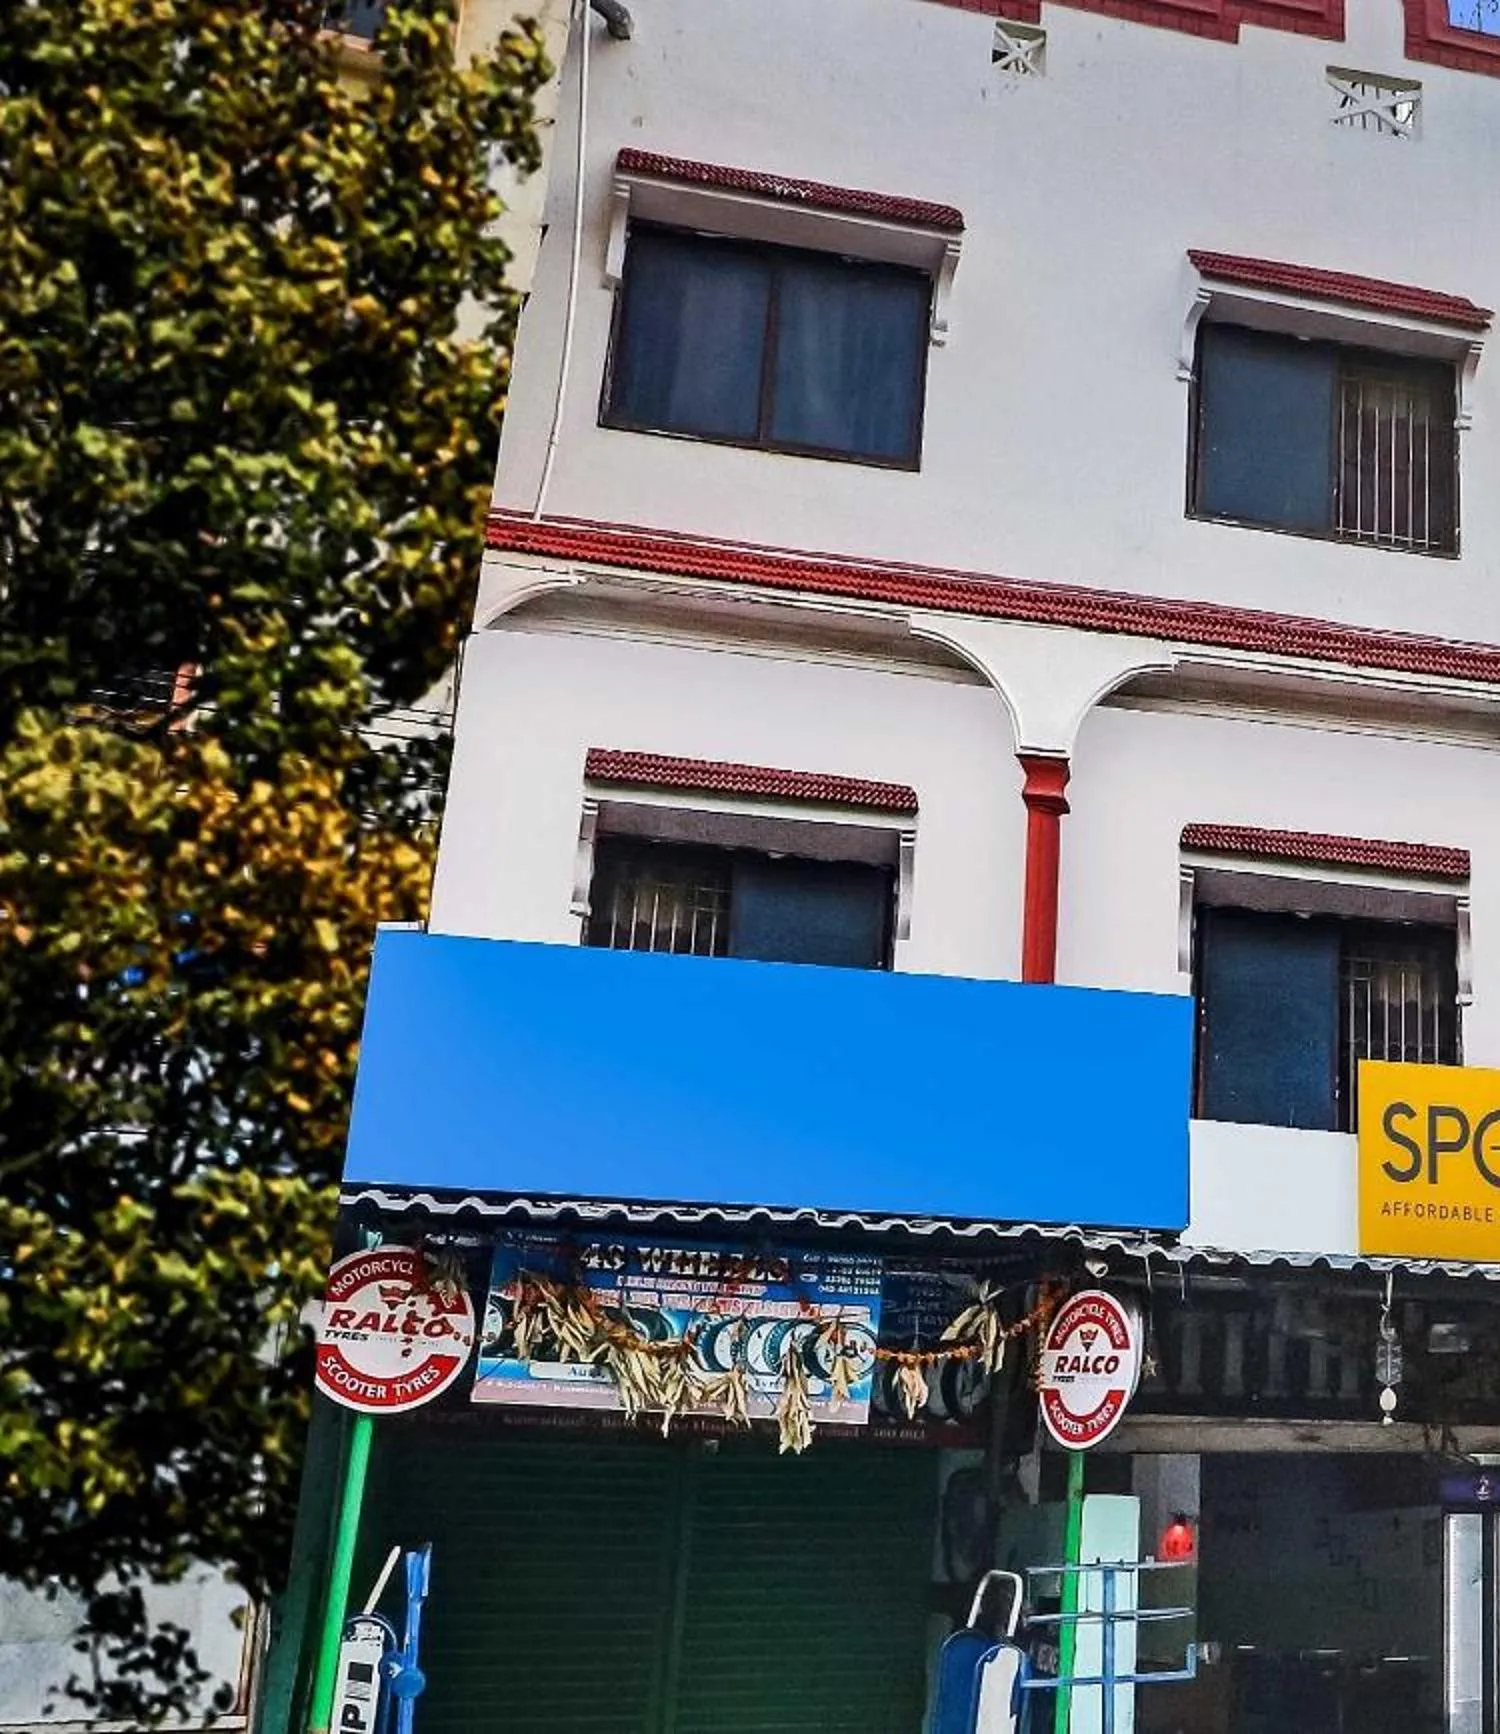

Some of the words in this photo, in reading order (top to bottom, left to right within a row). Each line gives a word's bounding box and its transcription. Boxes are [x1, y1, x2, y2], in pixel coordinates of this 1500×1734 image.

[1381, 1200, 1494, 1224] AFFORDABLE
[324, 1329, 370, 1342] TYRES
[1053, 1355, 1121, 1375] RALCO
[321, 1356, 387, 1399] SCOOTER
[391, 1365, 441, 1397] TYRES
